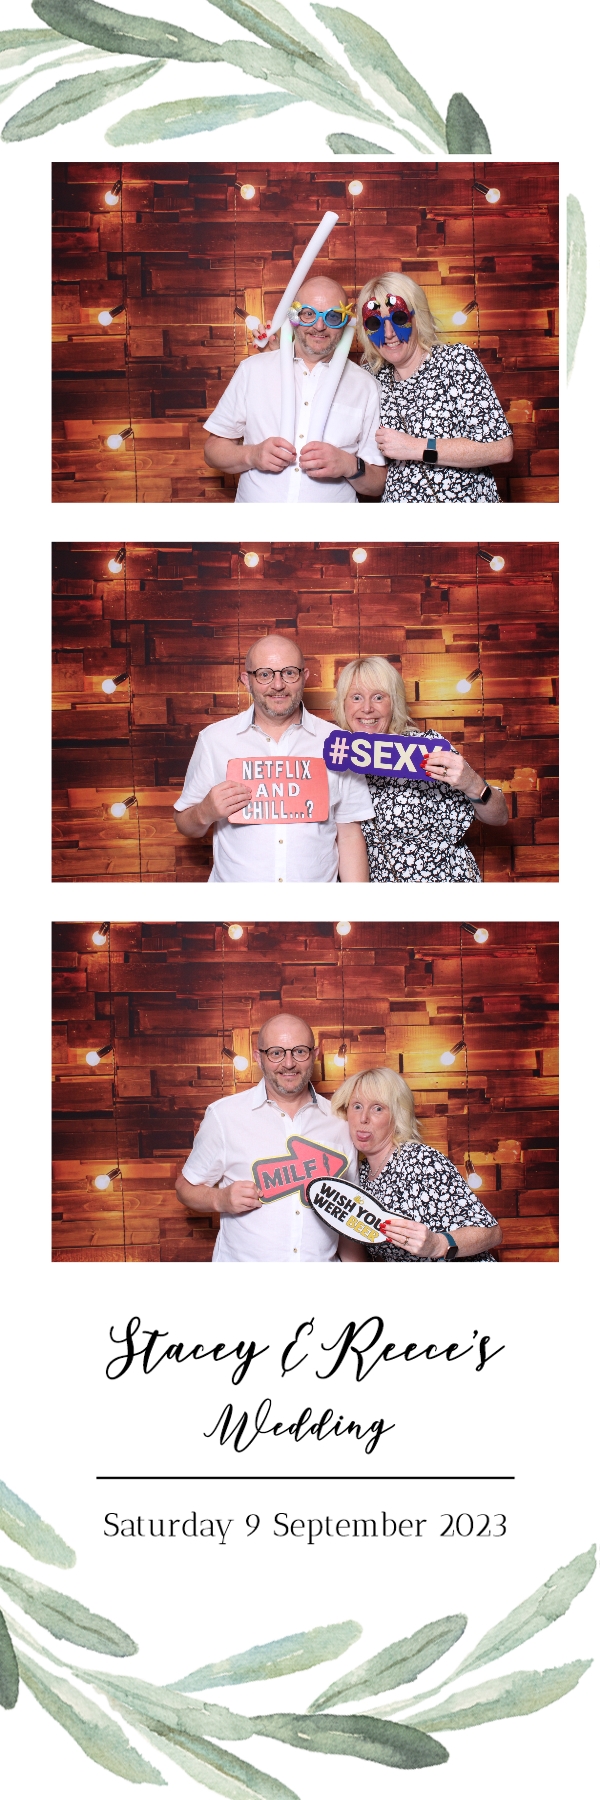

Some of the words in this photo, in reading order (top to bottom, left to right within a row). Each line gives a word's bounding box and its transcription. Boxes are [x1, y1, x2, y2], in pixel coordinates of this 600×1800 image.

[242, 760, 312, 780] NETFLIX
[255, 782, 301, 798] AND
[242, 799, 314, 820] CHILL...?
[261, 1158, 318, 1190] MILF
[320, 1182, 357, 1213] WISH
[313, 1193, 348, 1223] WERE
[346, 1215, 380, 1243] BEER
